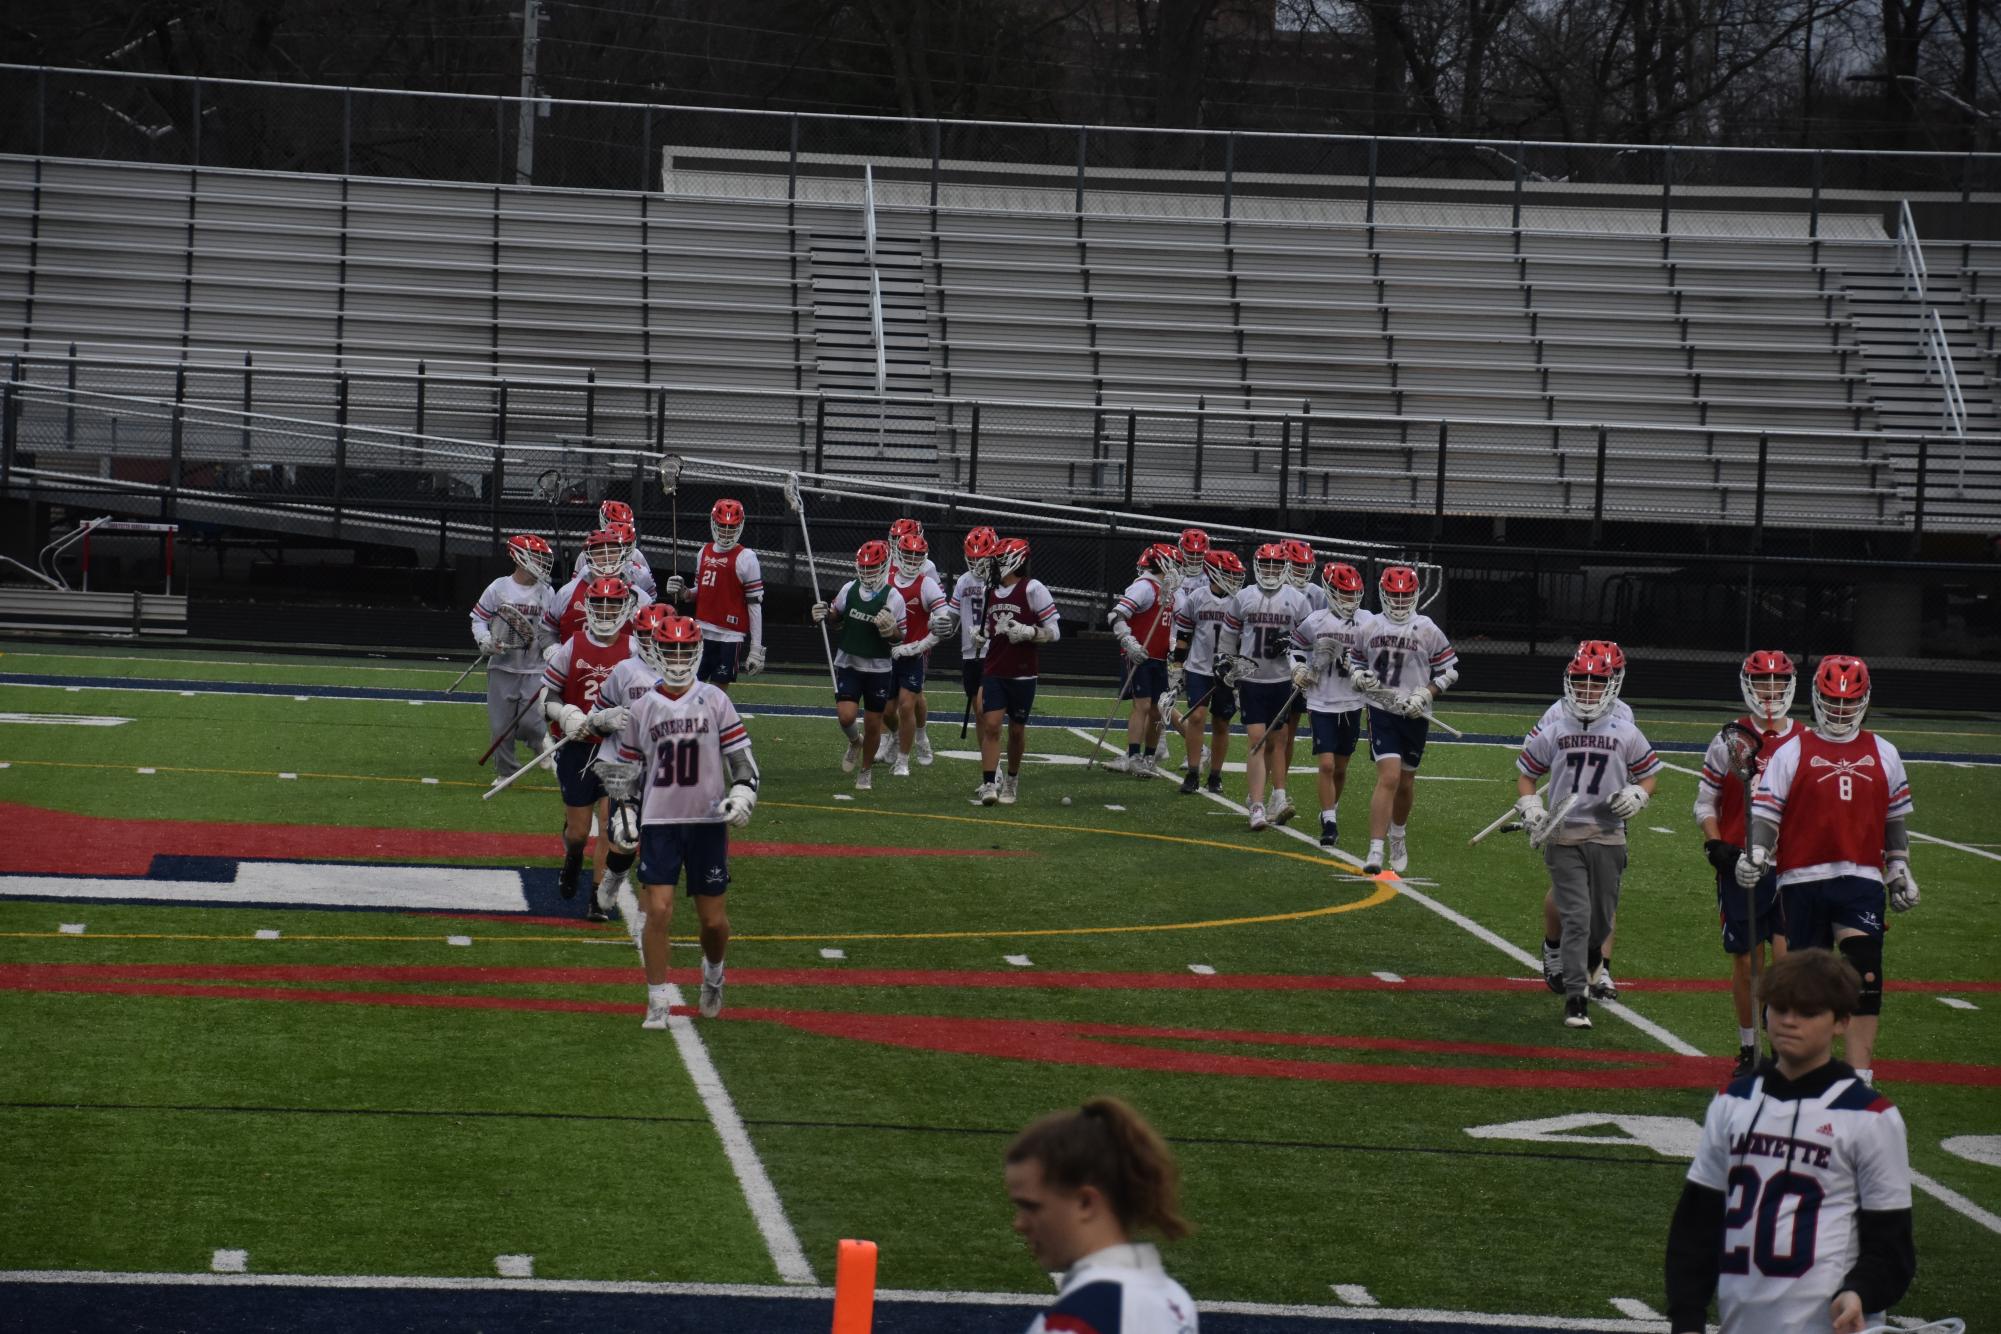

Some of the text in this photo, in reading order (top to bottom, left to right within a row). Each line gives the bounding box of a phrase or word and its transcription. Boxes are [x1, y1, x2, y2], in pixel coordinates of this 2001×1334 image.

[701, 569, 717, 587] 21
[1198, 611, 1225, 621] GENER
[1247, 612, 1292, 625] GENERALS
[1316, 632, 1356, 645] GNERAL
[1369, 634, 1419, 651] GENERALS
[648, 717, 710, 742] GENERALS
[1558, 735, 1618, 751] GENERALS
[1566, 751, 1609, 795] 77
[1838, 775, 1853, 802] 8
[1718, 1164, 1826, 1278] 20
